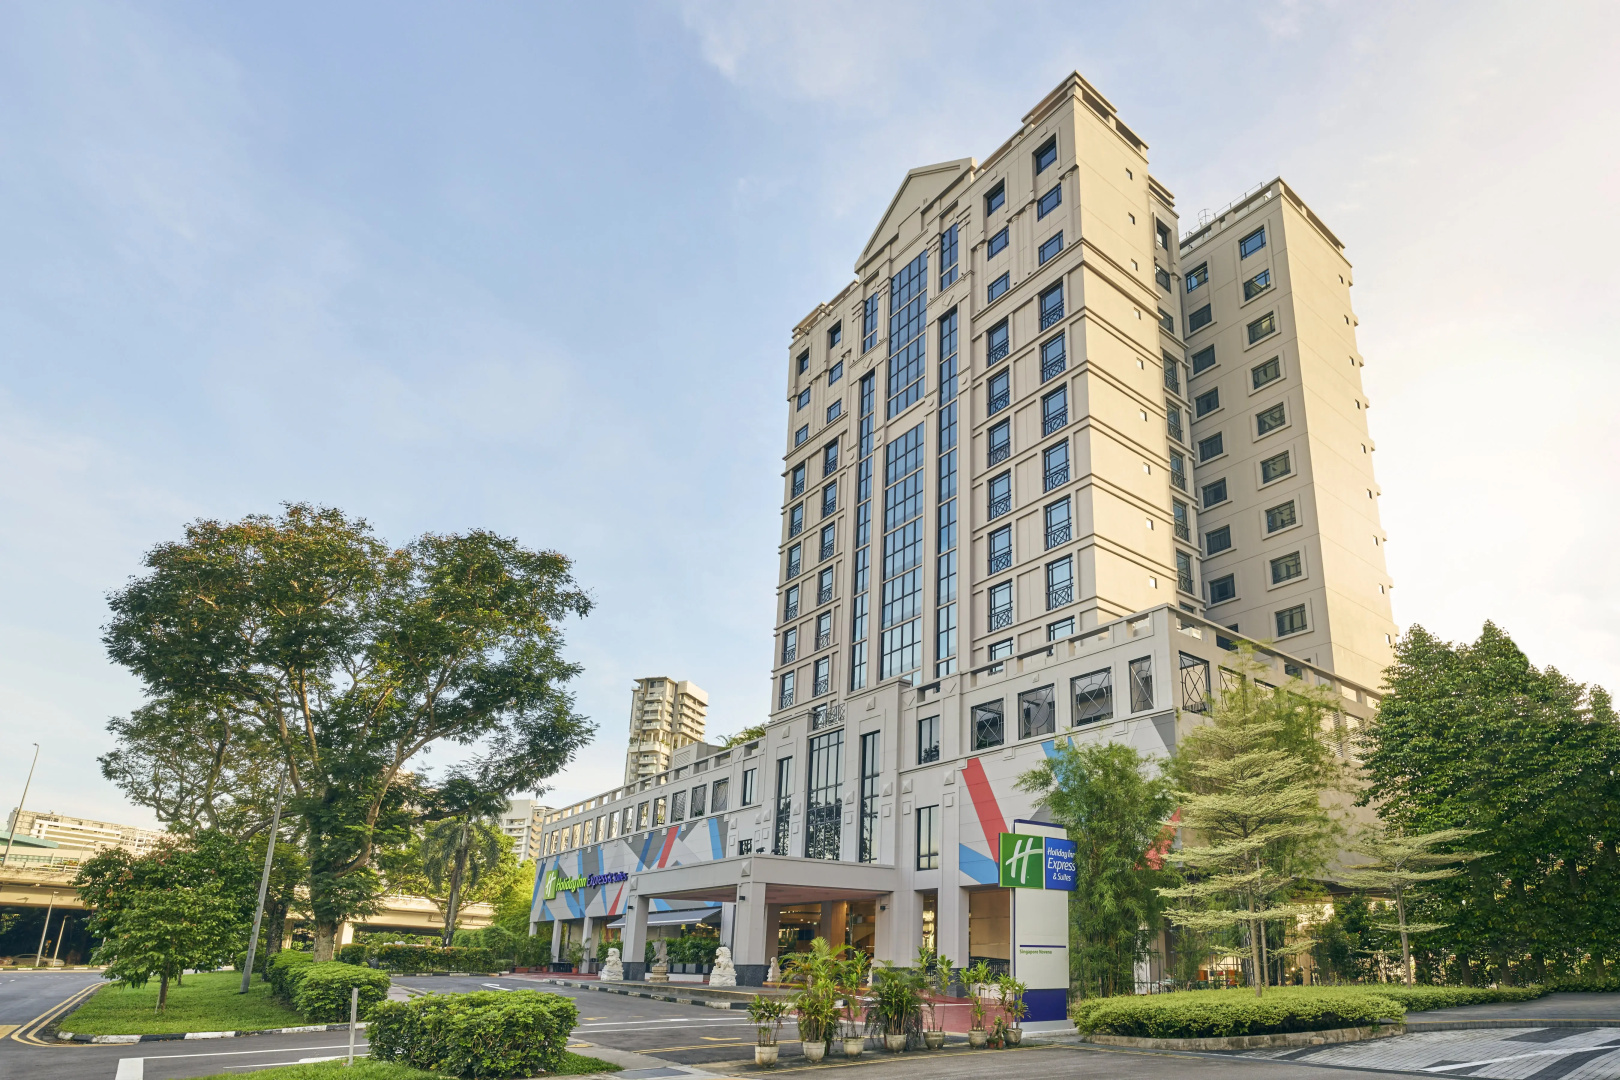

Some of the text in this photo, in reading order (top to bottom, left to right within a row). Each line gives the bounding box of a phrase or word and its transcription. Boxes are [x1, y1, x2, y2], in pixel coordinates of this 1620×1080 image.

[1047, 847, 1067, 859] Holiday
[1047, 857, 1076, 872] Express
[556, 876, 577, 893] Holiday
[577, 874, 587, 888] Inn
[586, 873, 608, 889] Express
[1052, 872, 1071, 882] & Suites
